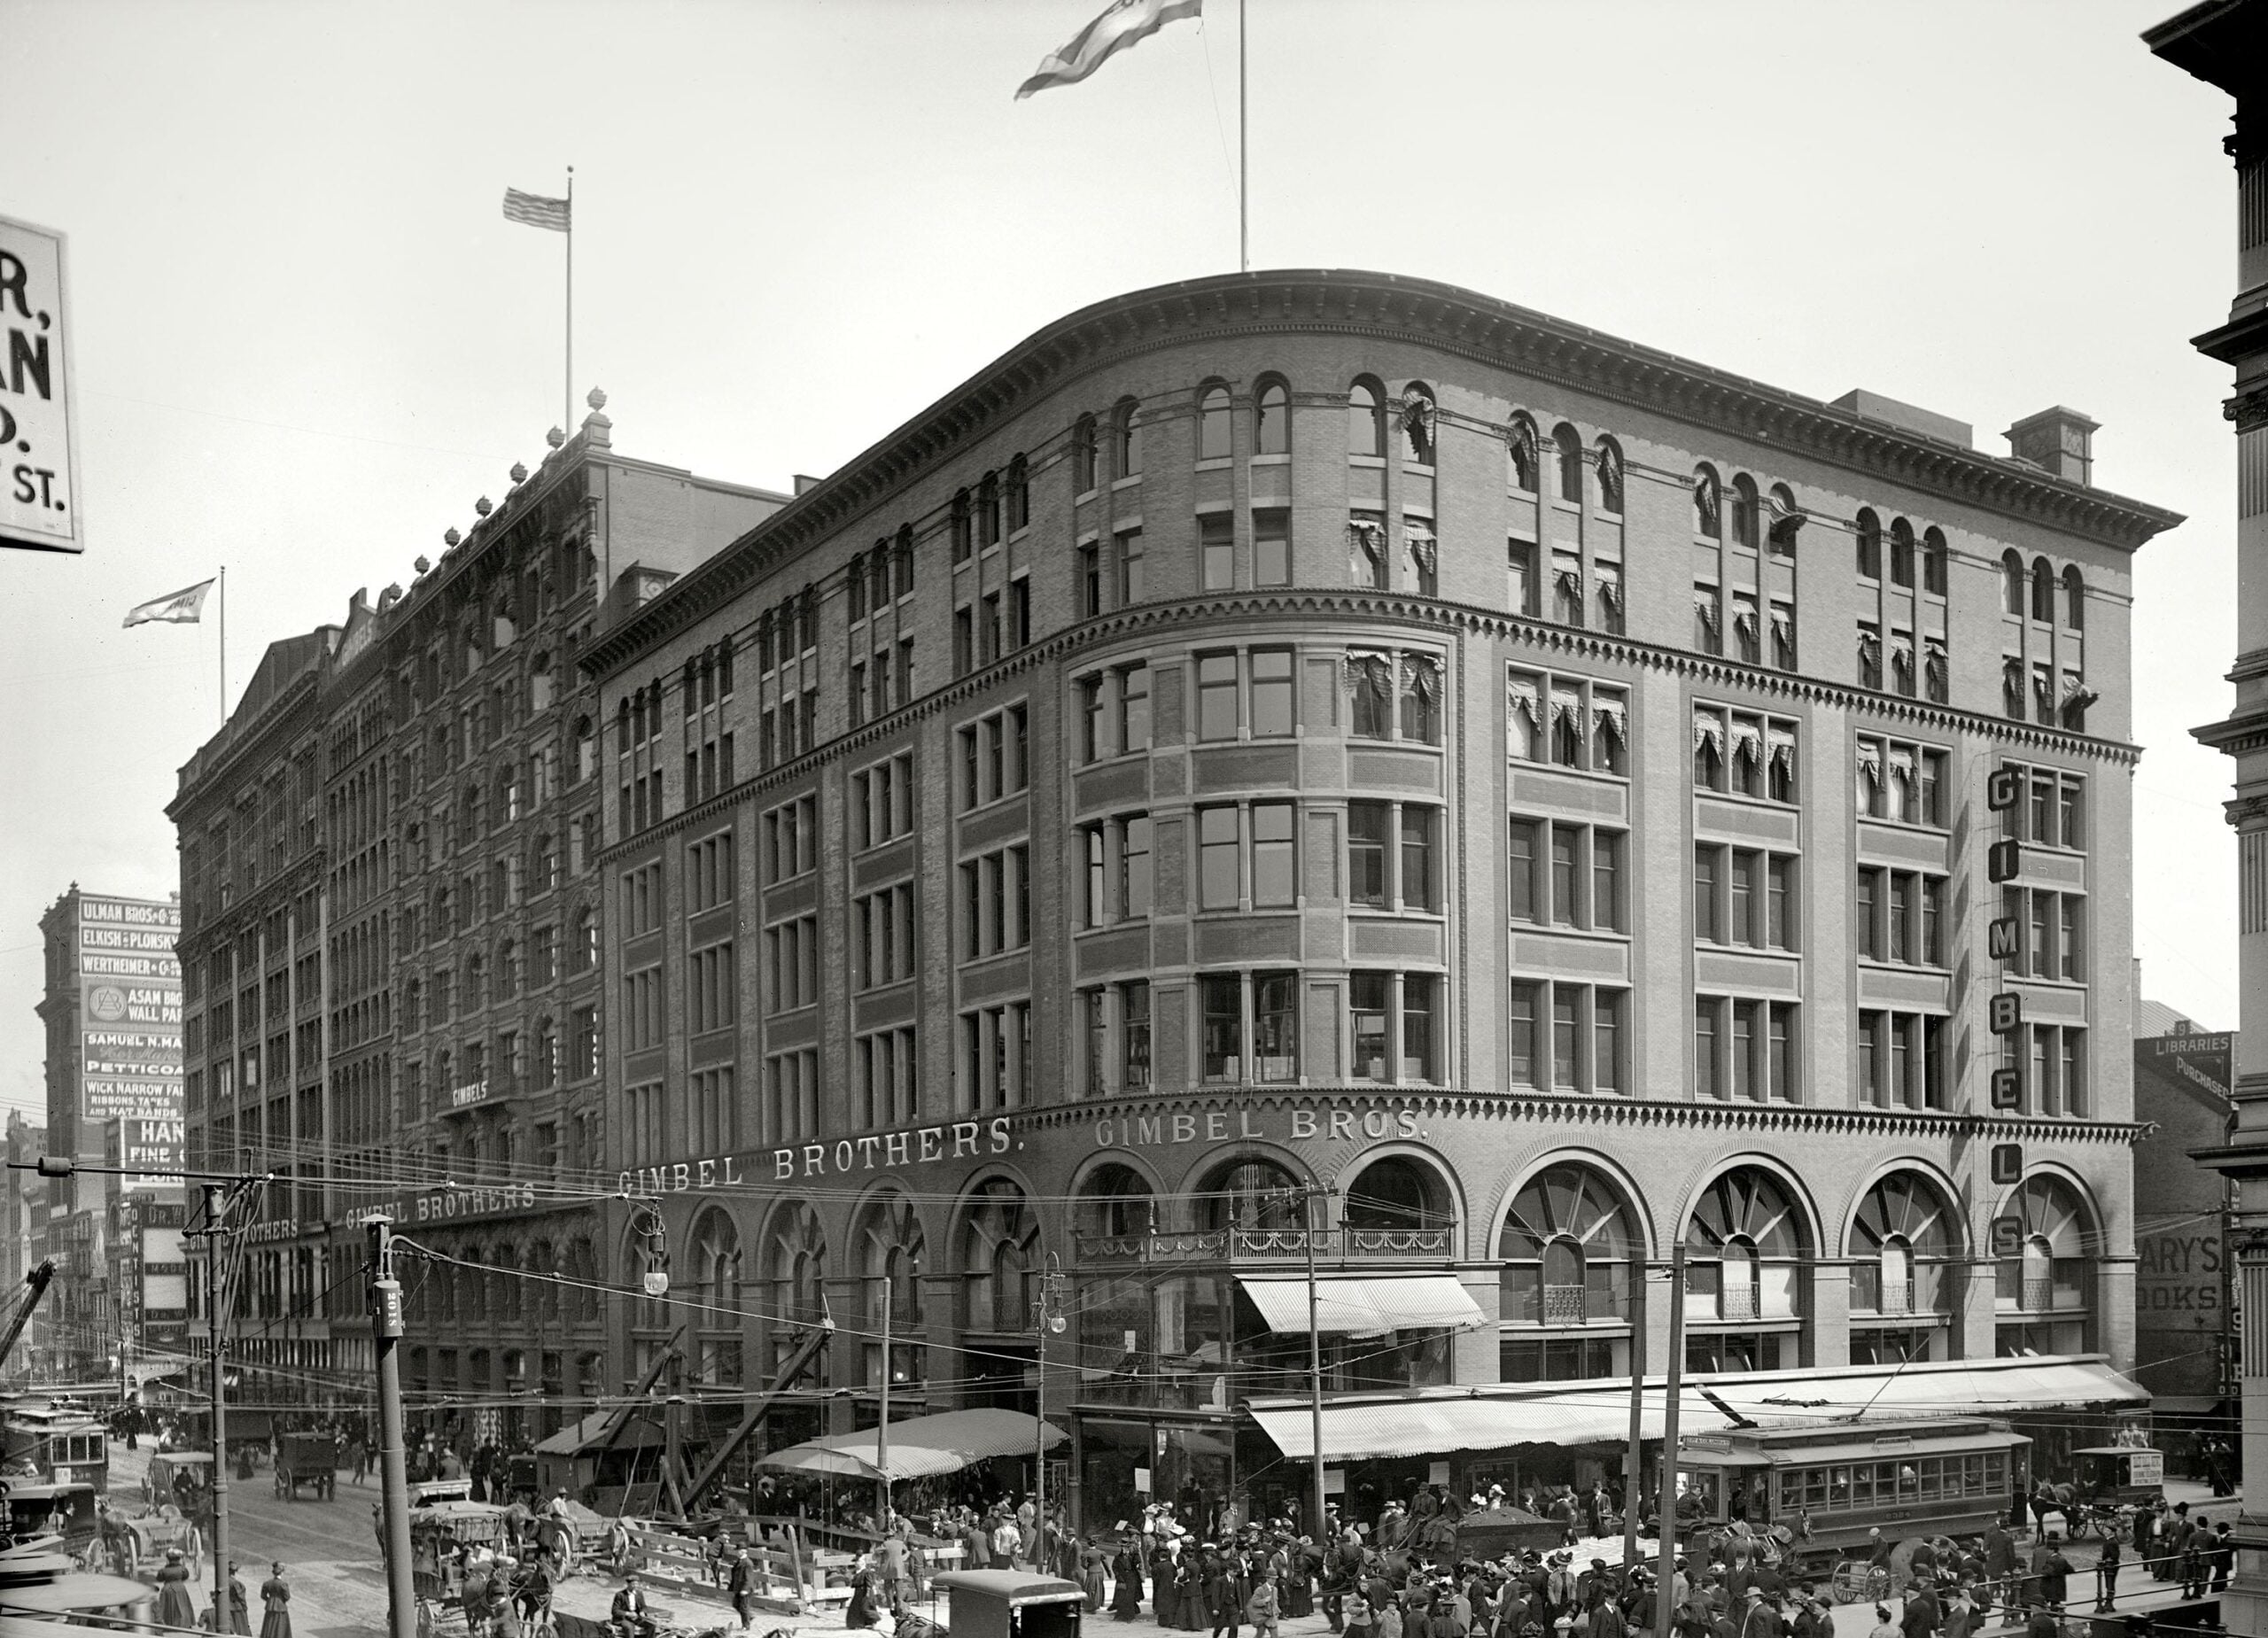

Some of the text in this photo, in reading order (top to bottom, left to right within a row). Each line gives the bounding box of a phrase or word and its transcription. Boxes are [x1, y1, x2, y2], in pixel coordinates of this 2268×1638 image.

[13, 464, 66, 512] ST.
[83, 928, 121, 948] ELKISH
[83, 956, 151, 975] WERTHEIMER
[128, 989, 161, 1005] ASAM
[128, 1005, 159, 1021] WALL
[1992, 772, 2020, 1253] GIMBELS
[88, 1033, 144, 1047] SAMUEL
[2155, 1036, 2229, 1056] LIBRARIES
[87, 1060, 184, 1076] PETTICOA
[2176, 1055, 2229, 1100] PURCHASED
[86, 1080, 114, 1095] WICK
[116, 1082, 164, 1097] NARROW
[452, 1079, 489, 1107] GIMBELS
[108, 1106, 135, 1116] HAT
[136, 1107, 178, 1119] BANDS
[1094, 1109, 1429, 1148] GIMBEL BROS.
[130, 1146, 171, 1163] FINE
[618, 1116, 1024, 1197] GIMBEL BROTHERS.
[416, 1182, 535, 1222] BROTHERS
